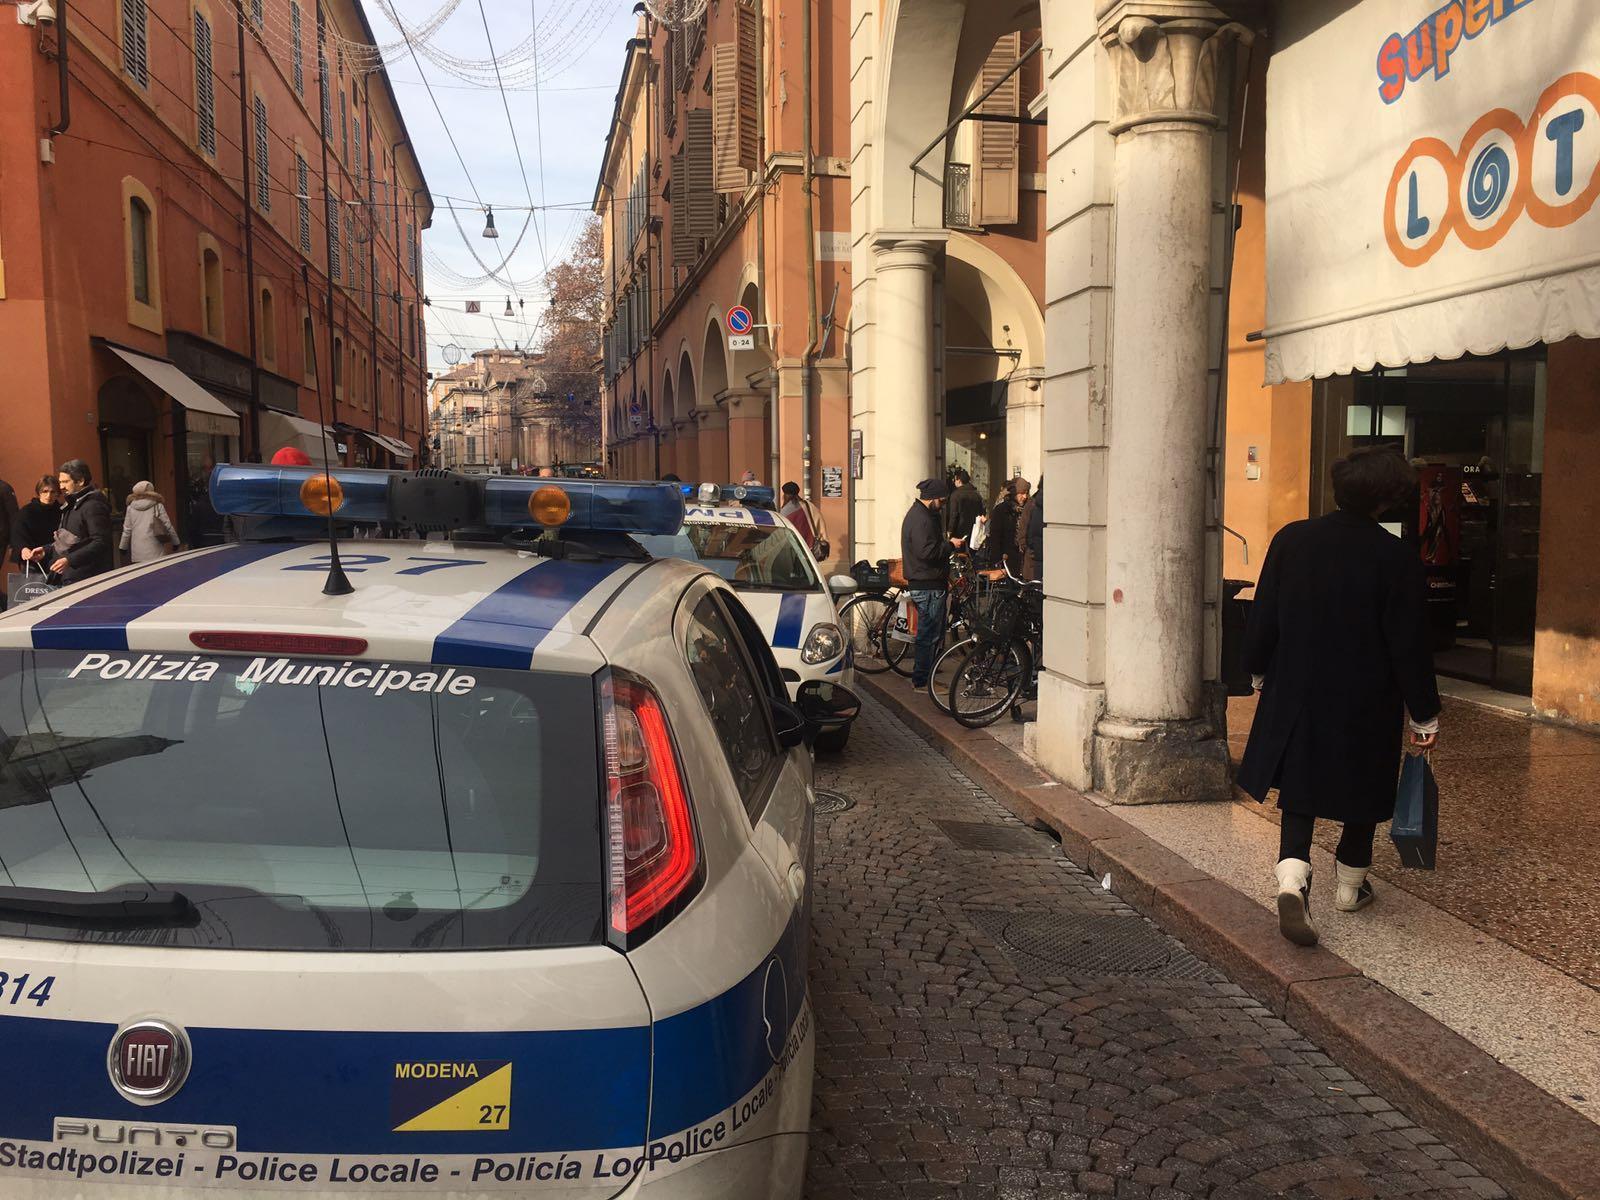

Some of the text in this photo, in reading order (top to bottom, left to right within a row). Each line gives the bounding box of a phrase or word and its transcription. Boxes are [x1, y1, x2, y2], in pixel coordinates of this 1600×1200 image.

[1377, 0, 1534, 105] Supe
[279, 554, 488, 576] 27
[67, 653, 477, 696] Polizia Municipale
[126, 1043, 169, 1077] FIAT
[395, 1063, 479, 1079] MODENA
[478, 1104, 507, 1124] 27
[649, 1120, 726, 1172] Police
[732, 1077, 774, 1131] Locale
[0, 1141, 185, 1179] Stadtpolizei
[215, 1154, 318, 1182] Police
[328, 1158, 439, 1183] Locale
[471, 1153, 582, 1183] Policía
